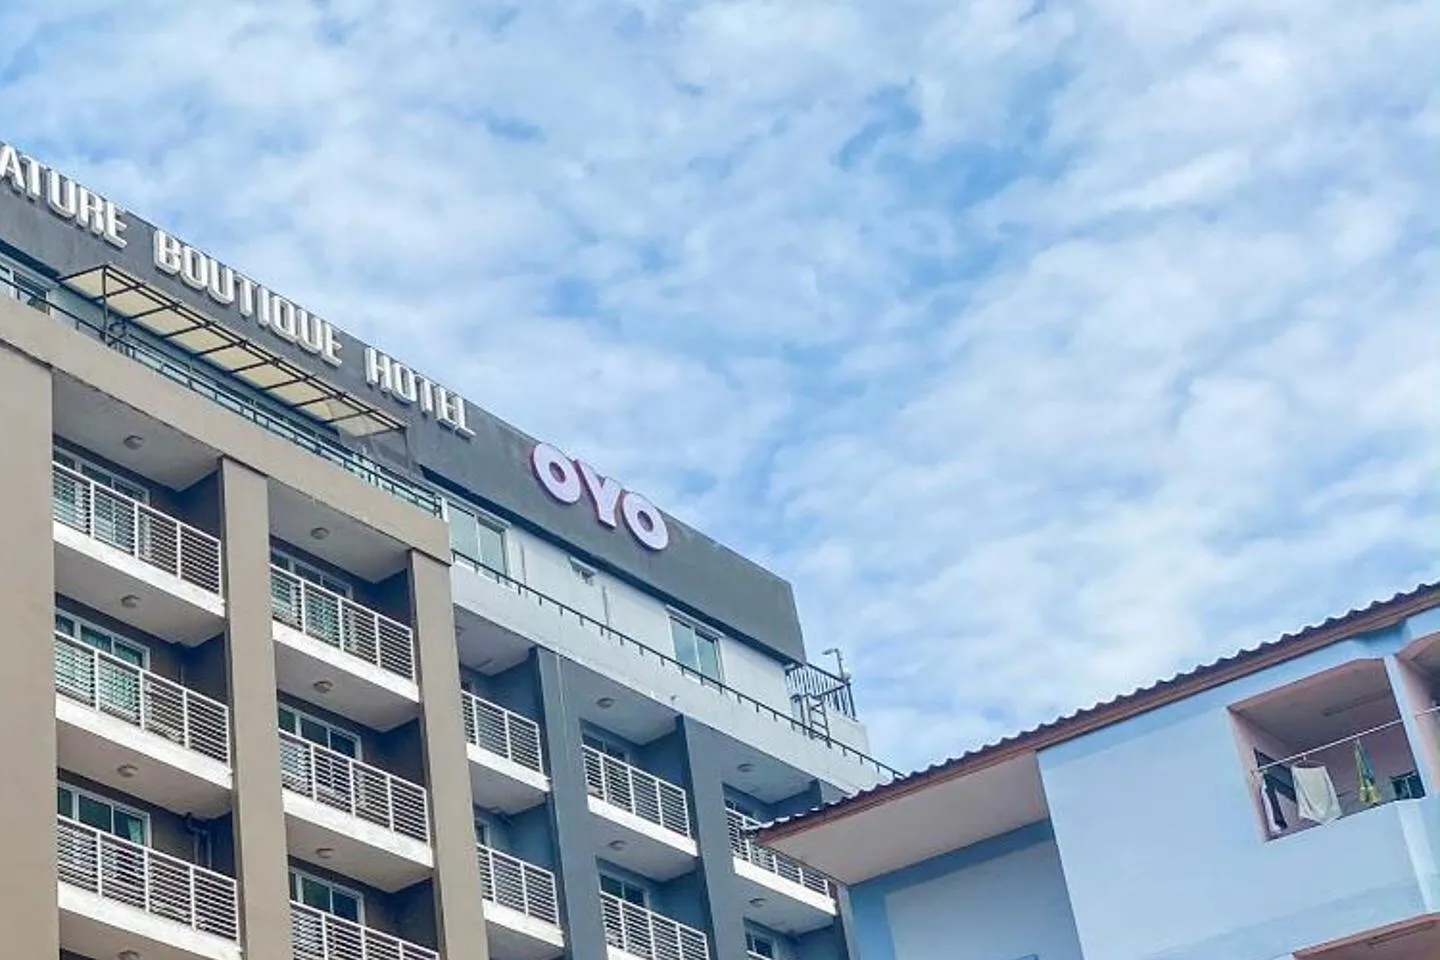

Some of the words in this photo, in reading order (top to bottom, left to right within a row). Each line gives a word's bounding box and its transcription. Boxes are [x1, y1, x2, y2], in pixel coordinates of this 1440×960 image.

[153, 230, 343, 368] BOUTIQUE
[364, 347, 477, 440] HOTEL
[530, 442, 669, 550] OYO
